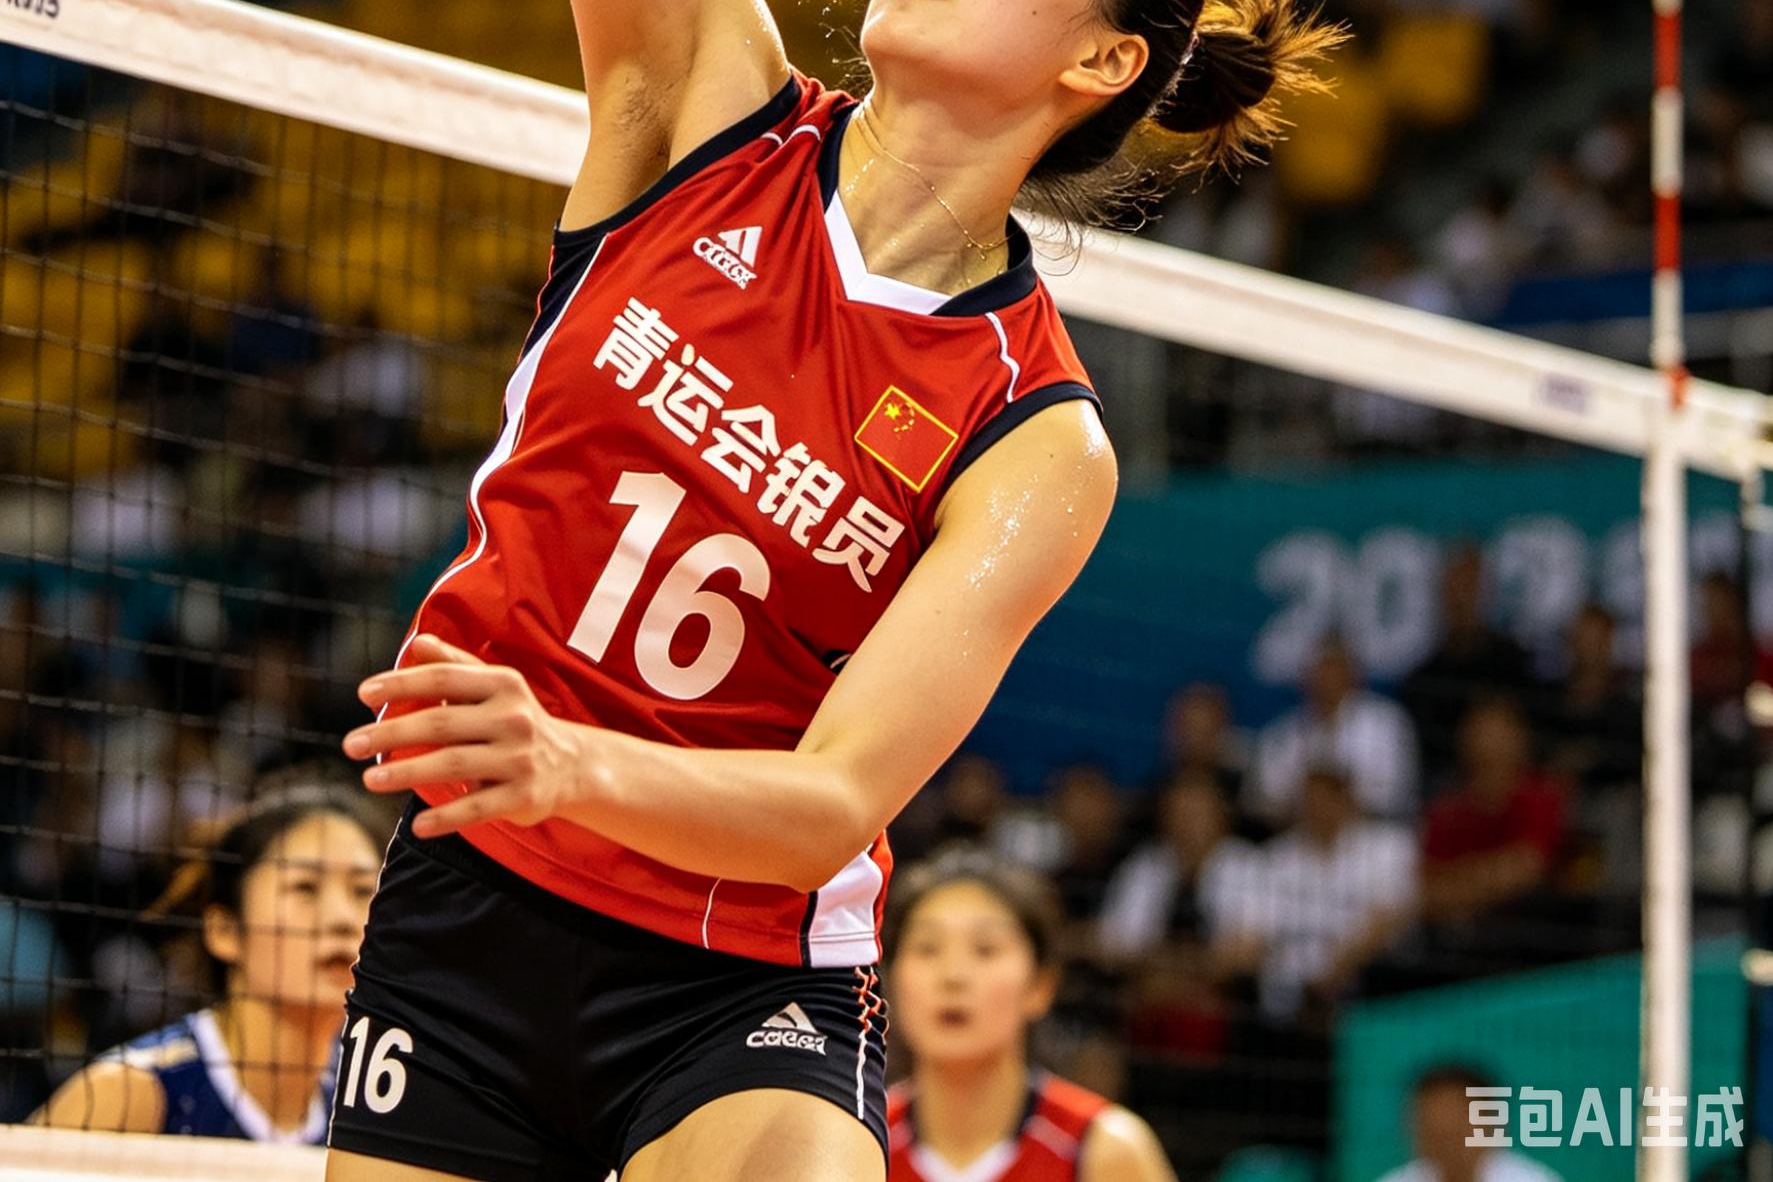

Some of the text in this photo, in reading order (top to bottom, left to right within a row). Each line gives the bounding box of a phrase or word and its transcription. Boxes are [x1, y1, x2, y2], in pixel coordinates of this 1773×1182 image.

[592, 297, 906, 593] 青运会银员
[566, 471, 771, 700] 16
[342, 1016, 414, 1114] 16
